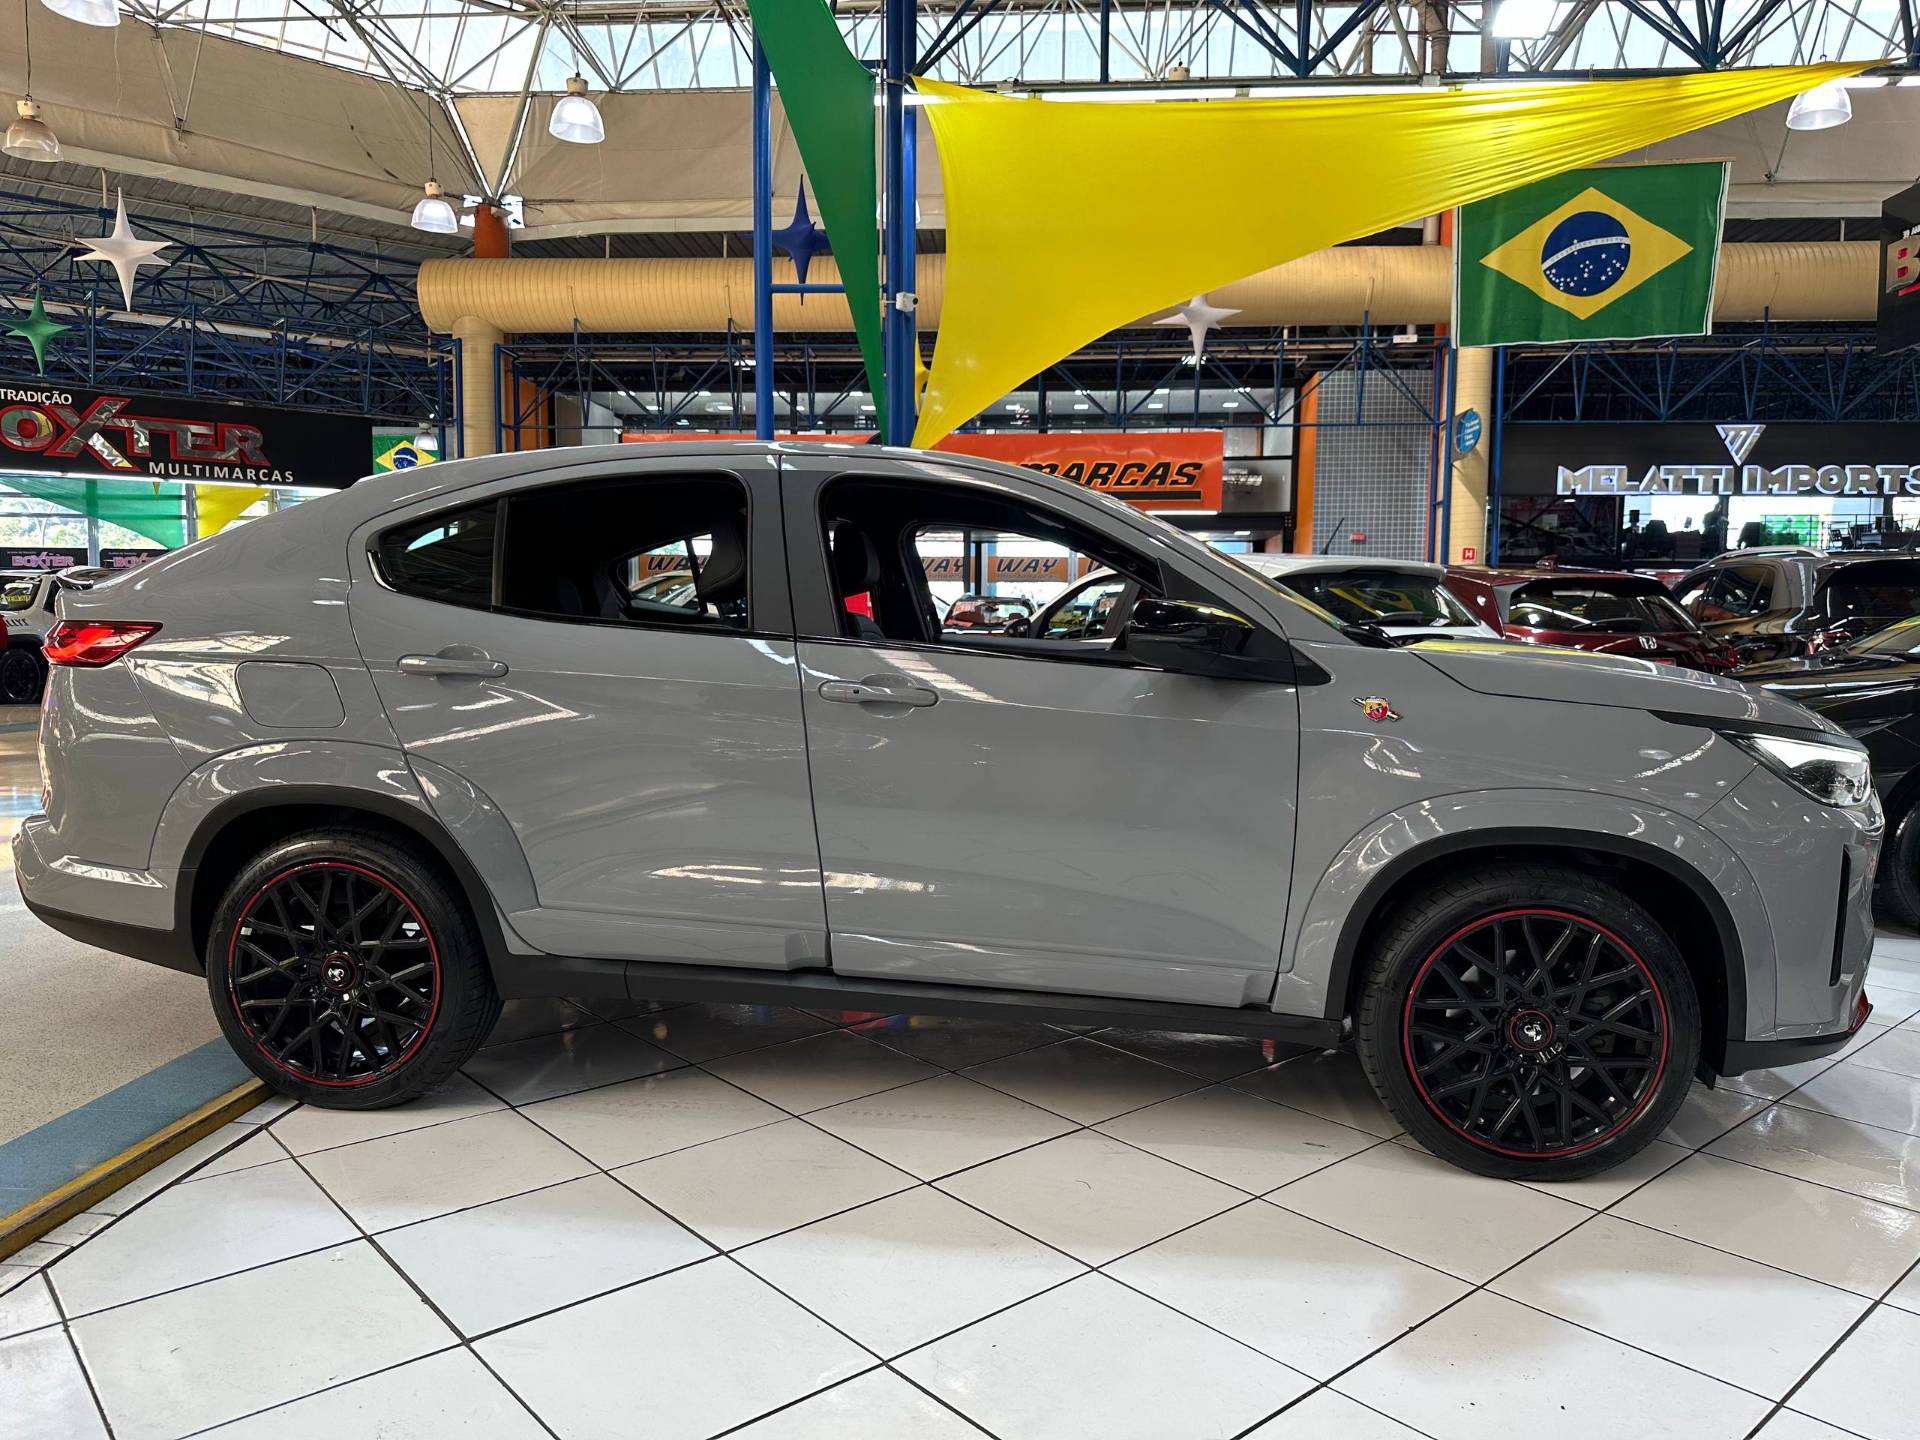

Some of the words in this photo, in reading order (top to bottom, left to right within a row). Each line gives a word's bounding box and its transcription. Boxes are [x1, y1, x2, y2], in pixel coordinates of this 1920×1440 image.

[0, 388, 72, 405] TRADIÇÃO
[149, 461, 294, 483] MULTIMARCAS
[1557, 465, 1734, 495] MELATTI
[996, 558, 1057, 573] WAY
